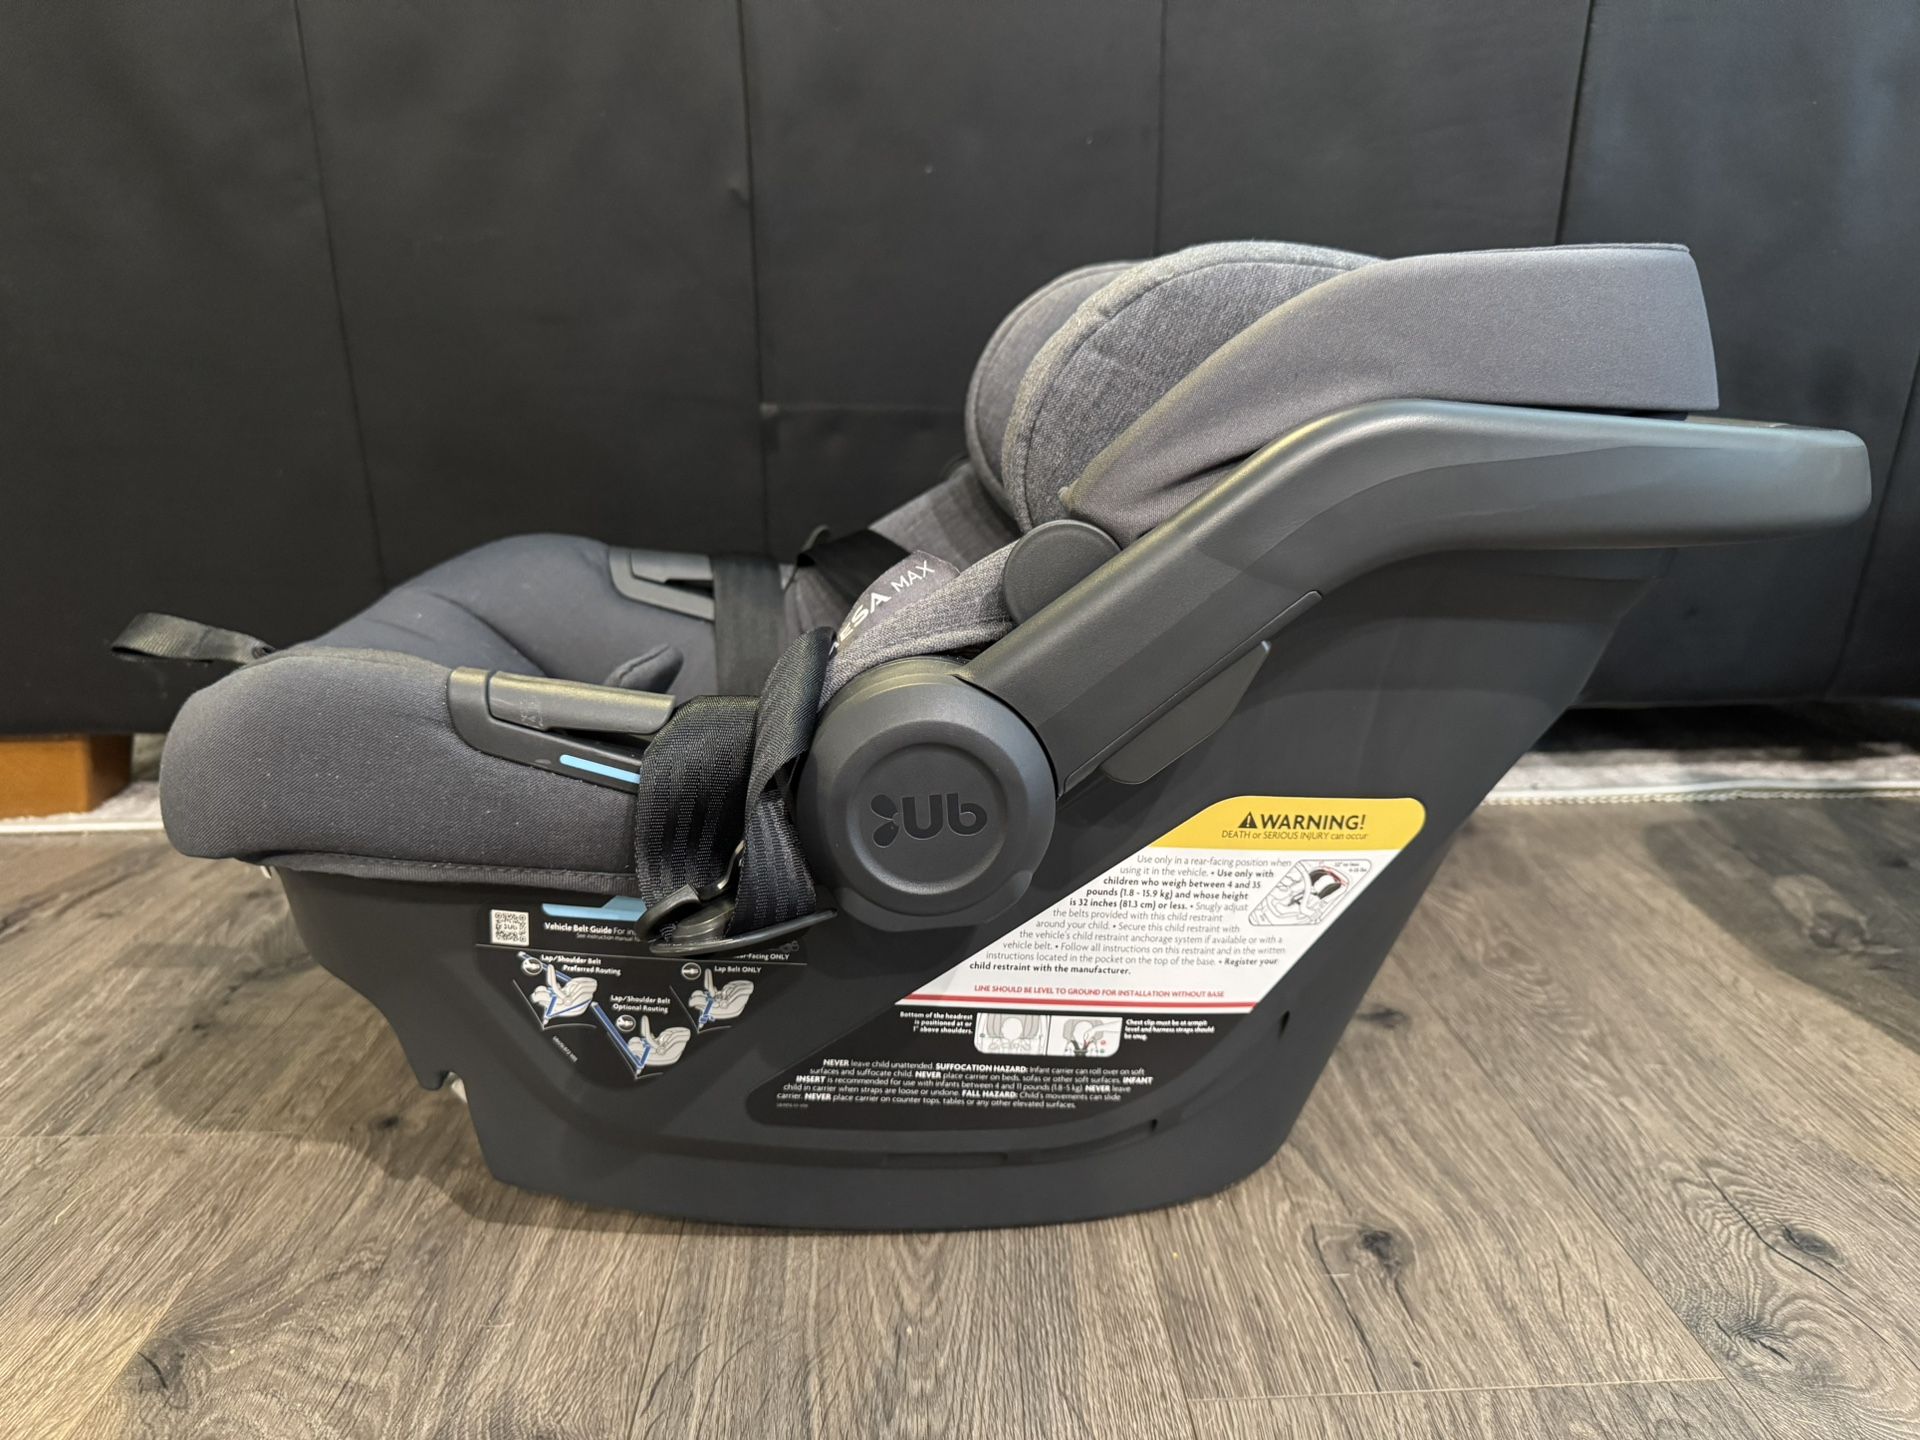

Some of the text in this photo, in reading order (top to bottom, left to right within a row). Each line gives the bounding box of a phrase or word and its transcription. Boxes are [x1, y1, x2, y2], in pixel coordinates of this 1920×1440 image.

[891, 560, 935, 592] MAX
[1261, 813, 1365, 830] WARNING!
[1221, 830, 1250, 838] DEATH
[1263, 831, 1298, 839] SERIOUS
[1300, 832, 1329, 840] INJURY
[1104, 876, 1138, 885] children
[1142, 877, 1159, 886] who
[1162, 877, 1186, 889] weigh
[1189, 878, 1225, 888] between
[1235, 880, 1250, 888] and
[1087, 887, 1117, 898] pounds
[1143, 888, 1157, 897] 15.9
[1160, 889, 1172, 900] kg)
[1175, 889, 1191, 898] and
[1194, 890, 1219, 899] whose
[1222, 891, 1248, 902] height
[1091, 898, 1116, 907] inches
[1141, 899, 1155, 911] cm)
[1170, 900, 1187, 909] less.
[1196, 901, 1222, 912] Snugly
[1224, 902, 1248, 913] adjust
[544, 922, 572, 931] Vehicle
[573, 924, 588, 932] Belt
[589, 926, 612, 934] Guide
[613, 927, 625, 935] For
[970, 960, 1130, 974] child restraint with the manufacturer.
[975, 984, 990, 992] LINE
[992, 985, 1022, 993] SHOULD
[1118, 989, 1170, 997] INSTALLATION
[936, 1063, 992, 1071] SUFFOCATION
